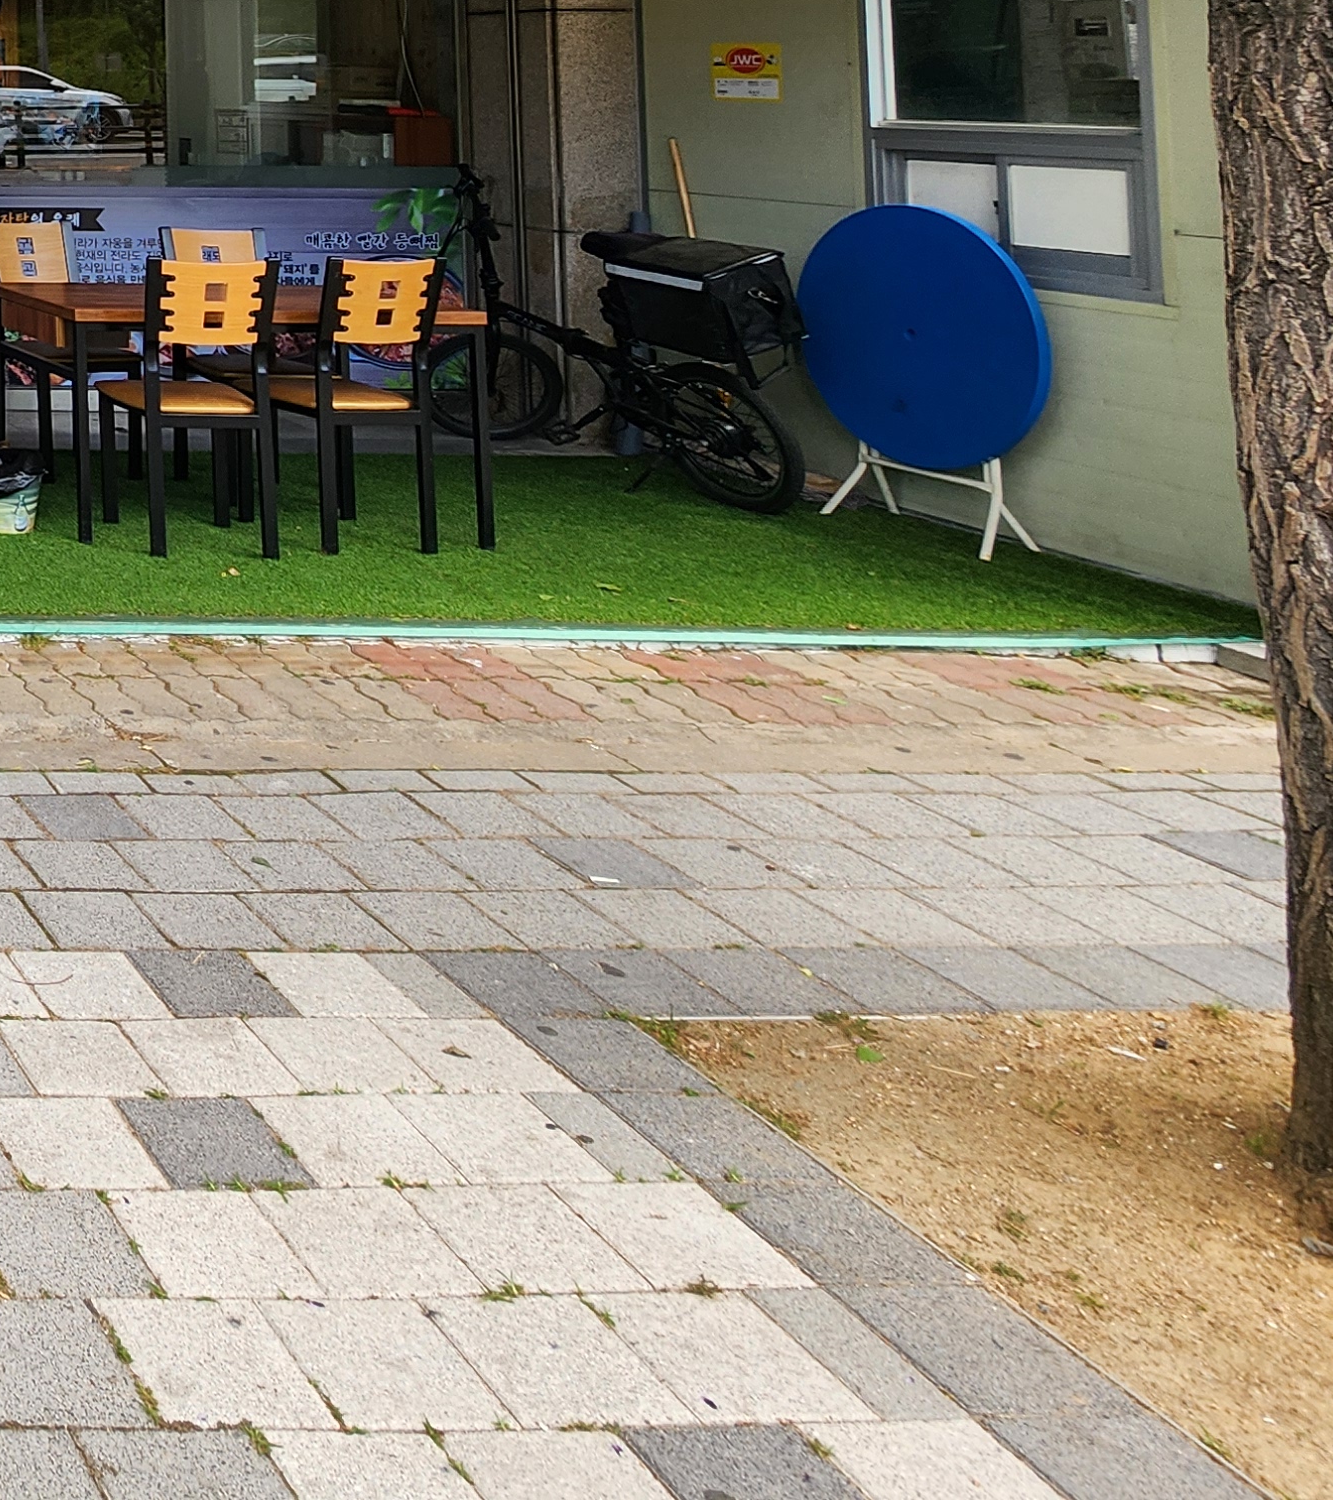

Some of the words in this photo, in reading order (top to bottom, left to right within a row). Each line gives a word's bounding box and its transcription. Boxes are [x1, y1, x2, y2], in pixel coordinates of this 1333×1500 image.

[730, 54, 762, 65] JWC
[74, 237, 98, 249] 라가
[102, 237, 134, 249] 자웅을
[305, 232, 352, 250] 매콤한
[356, 232, 389, 250] 빨간
[393, 232, 440, 250] 등뼈찜
[76, 250, 107, 261] 현재의
[110, 250, 142, 261] 전라도
